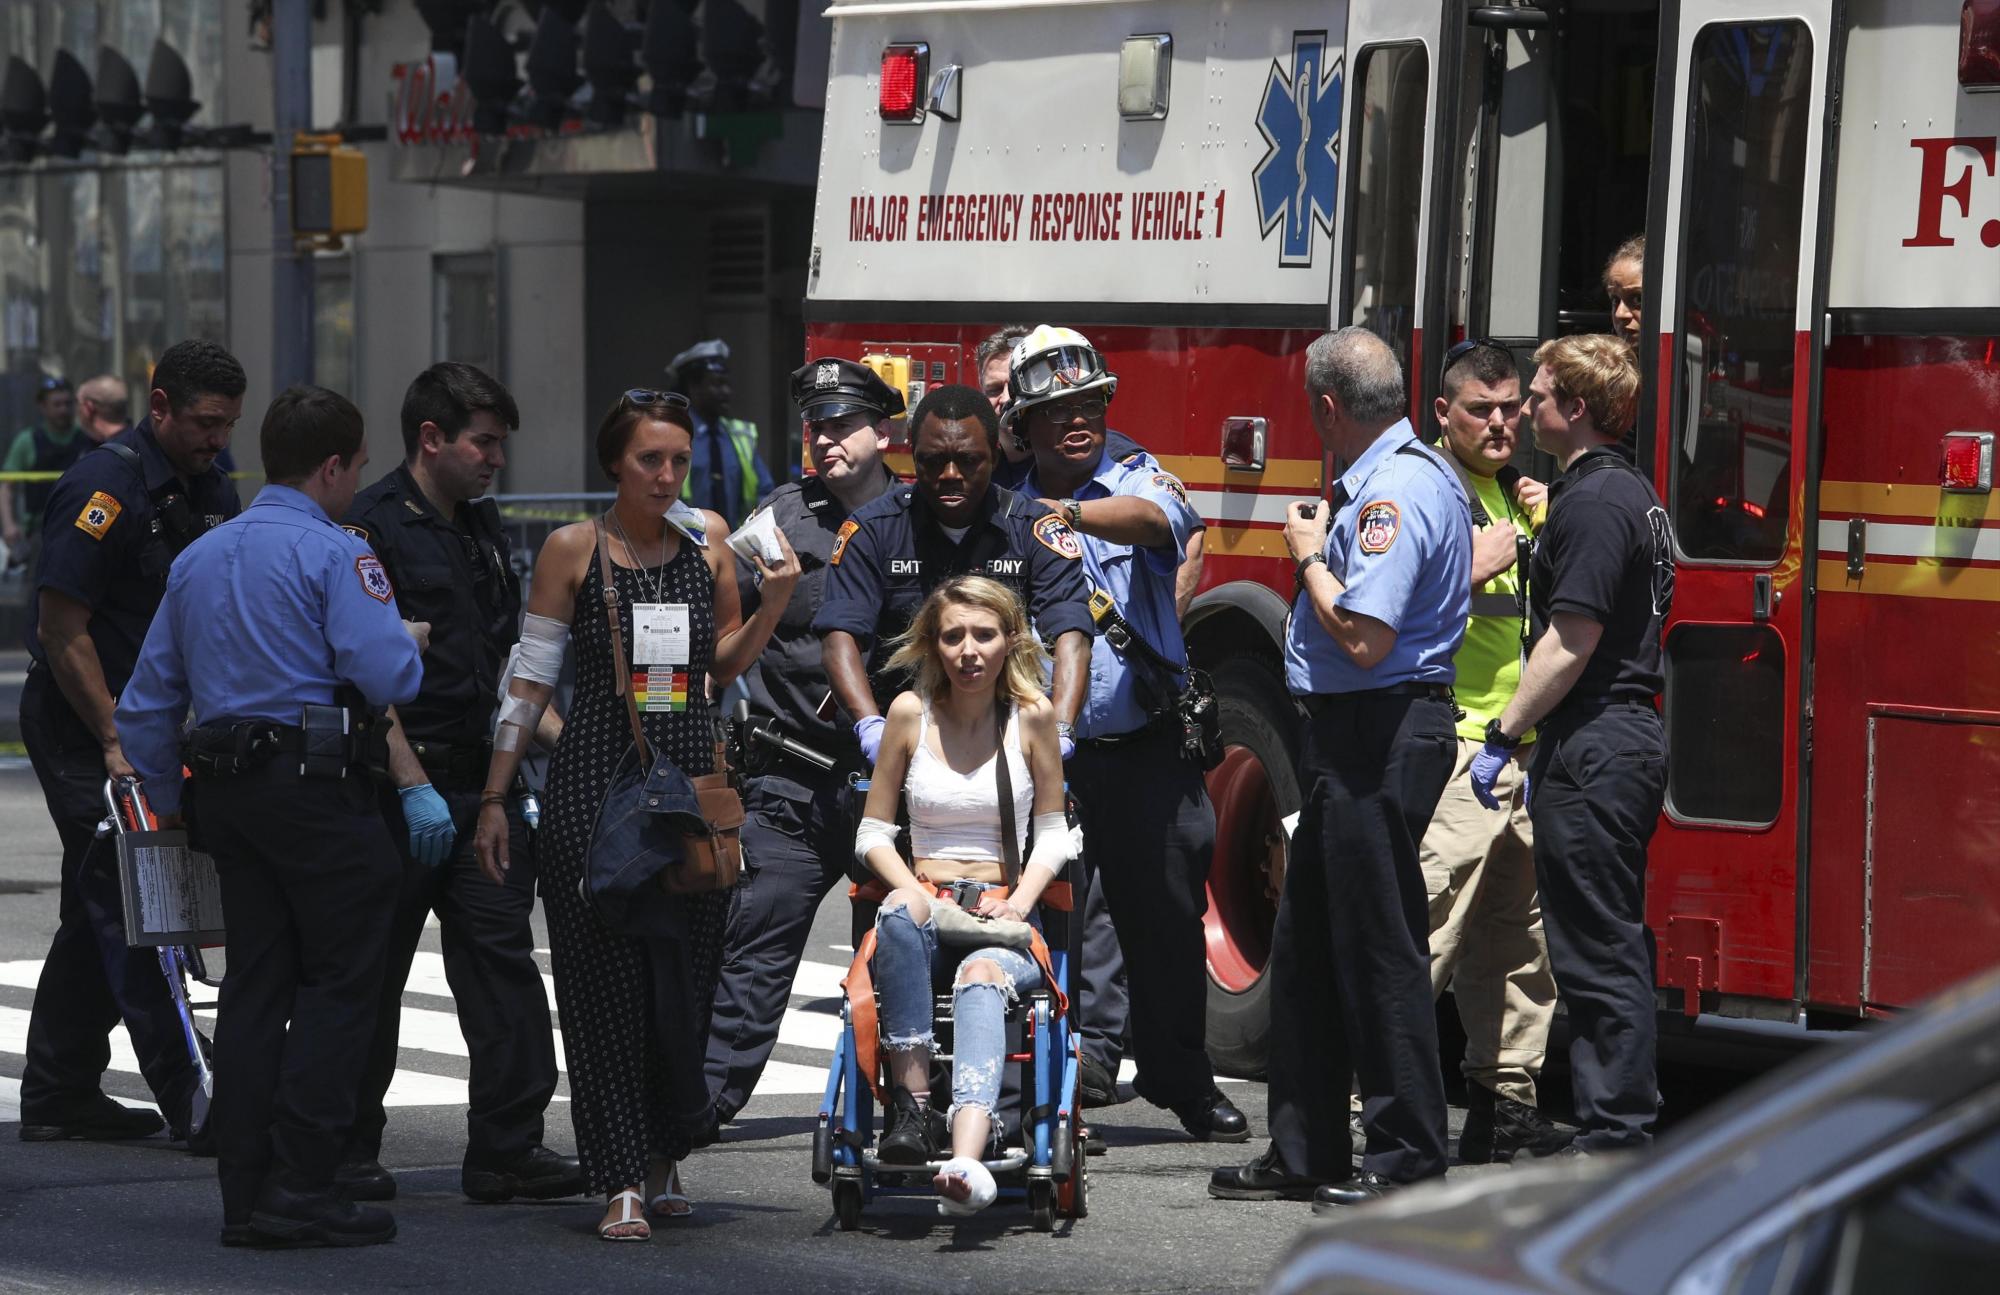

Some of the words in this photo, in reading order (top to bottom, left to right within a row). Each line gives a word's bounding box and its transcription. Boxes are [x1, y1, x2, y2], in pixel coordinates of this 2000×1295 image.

[849, 195, 909, 242] MAJOR
[916, 193, 1024, 242] EMERGENCY
[1029, 192, 1123, 241] RESPONSE
[1131, 190, 1205, 241] VEHICLE
[1214, 189, 1226, 238] 1
[891, 560, 923, 574] EMT
[986, 560, 1023, 574] FDNY
